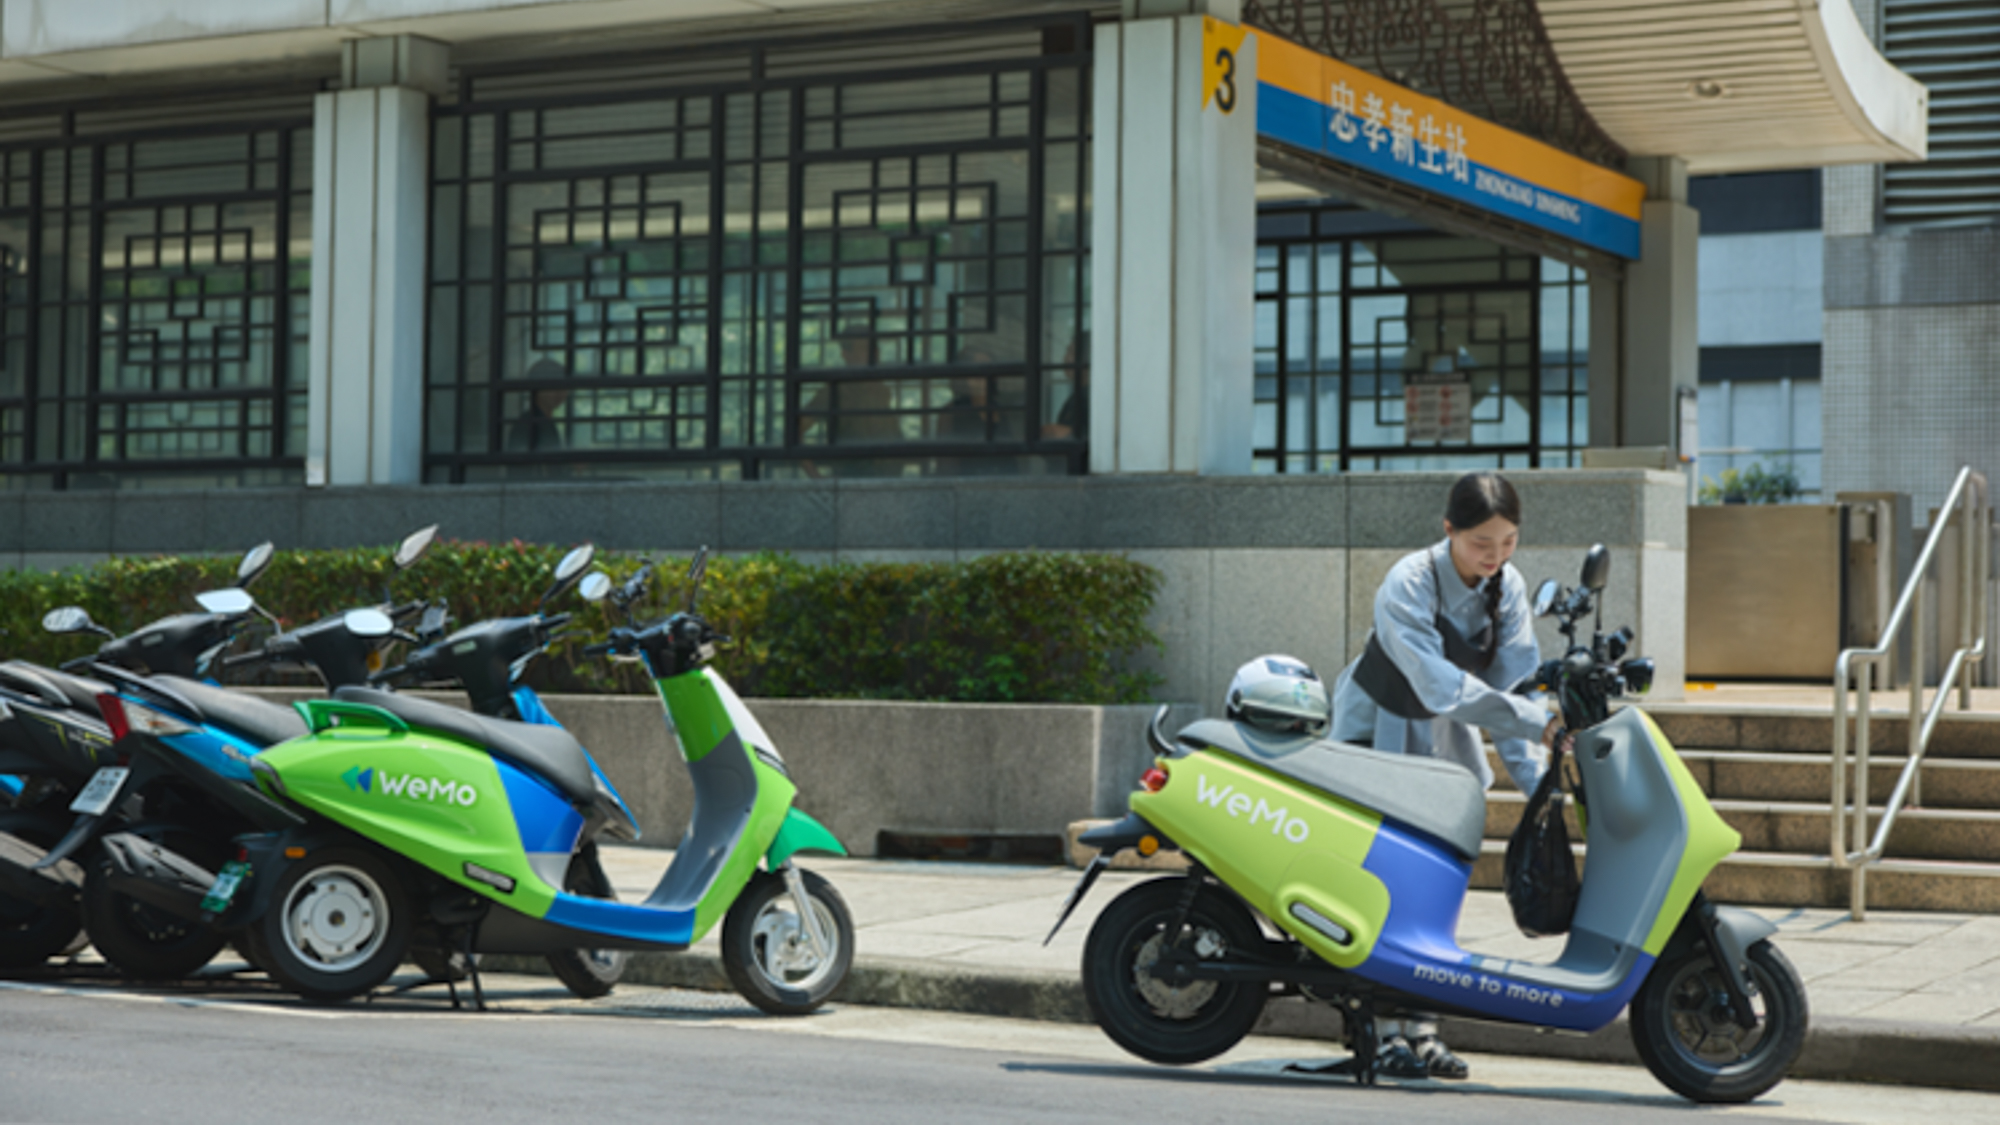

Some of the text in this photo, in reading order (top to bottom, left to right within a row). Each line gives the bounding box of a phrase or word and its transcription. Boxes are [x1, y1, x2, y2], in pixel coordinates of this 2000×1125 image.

[1214, 47, 1236, 113] 3
[1329, 79, 1469, 184] 忠孝新生站
[379, 769, 477, 806] WeMo
[1197, 773, 1310, 844] WeMo
[1413, 964, 1563, 1008] move to more
